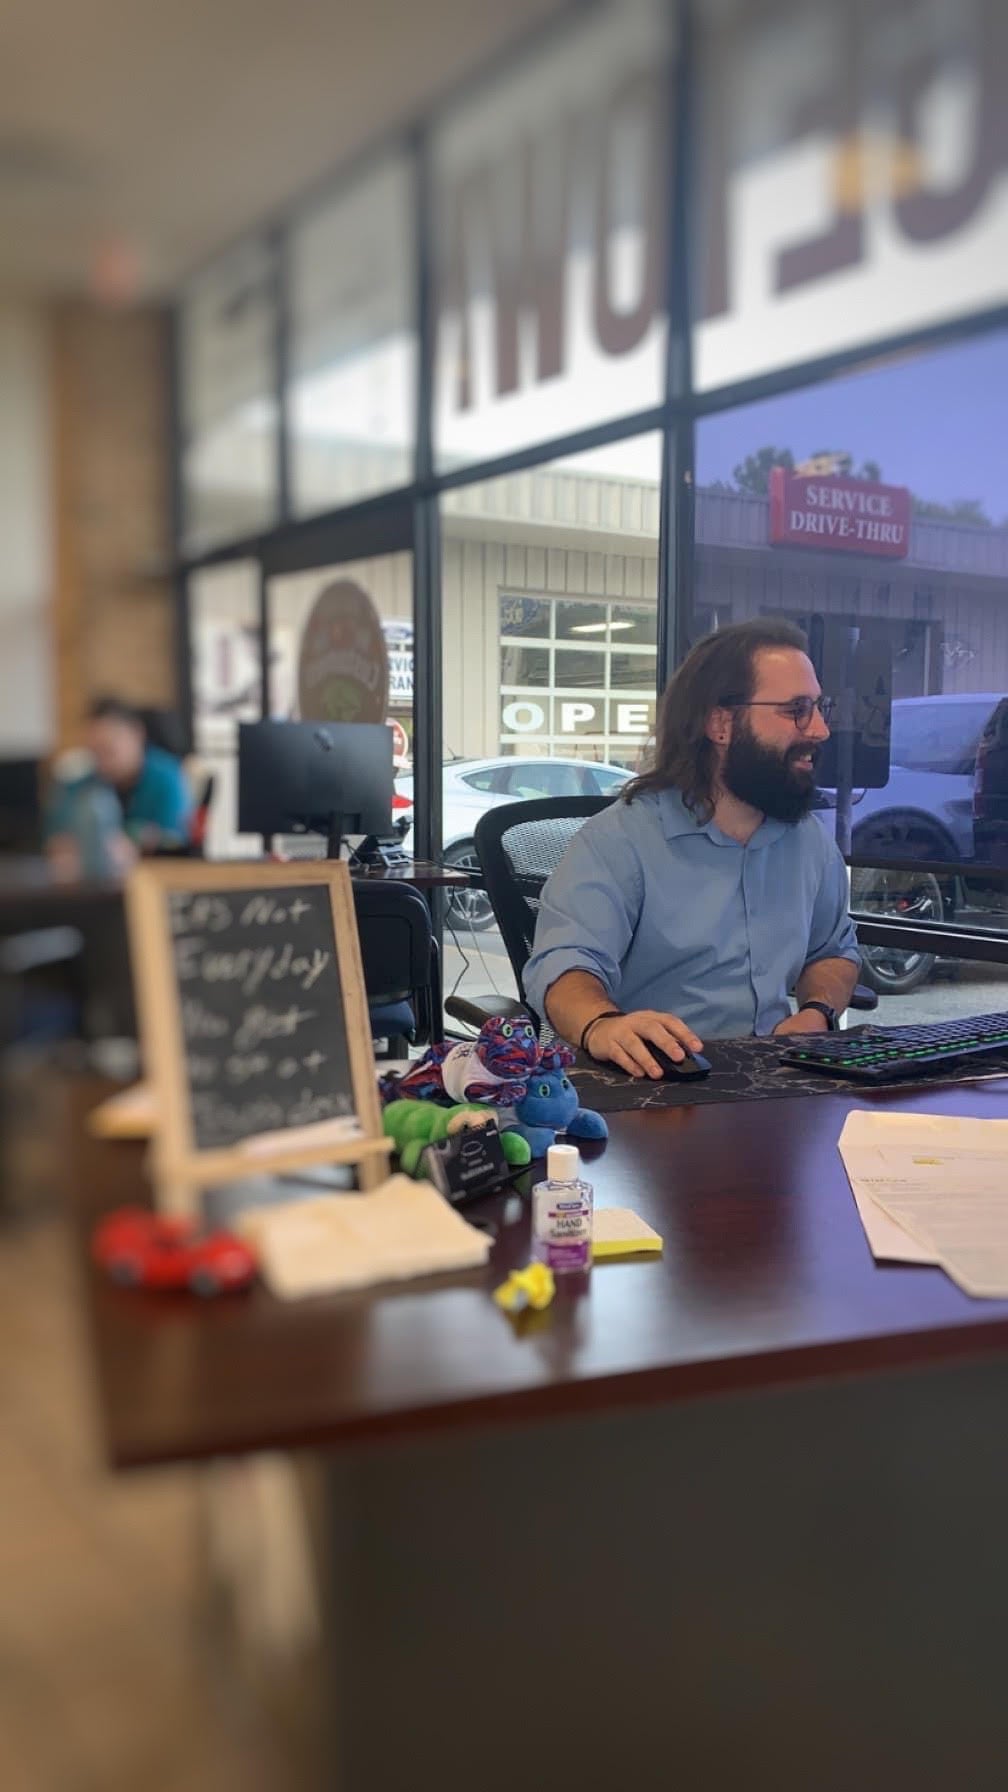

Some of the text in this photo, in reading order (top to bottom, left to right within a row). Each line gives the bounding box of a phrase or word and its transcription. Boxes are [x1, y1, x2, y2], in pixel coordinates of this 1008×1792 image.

[806, 484, 892, 517] SERVICE
[790, 510, 904, 544] DRIVE-THRU
[556, 1218, 583, 1228] HAND
